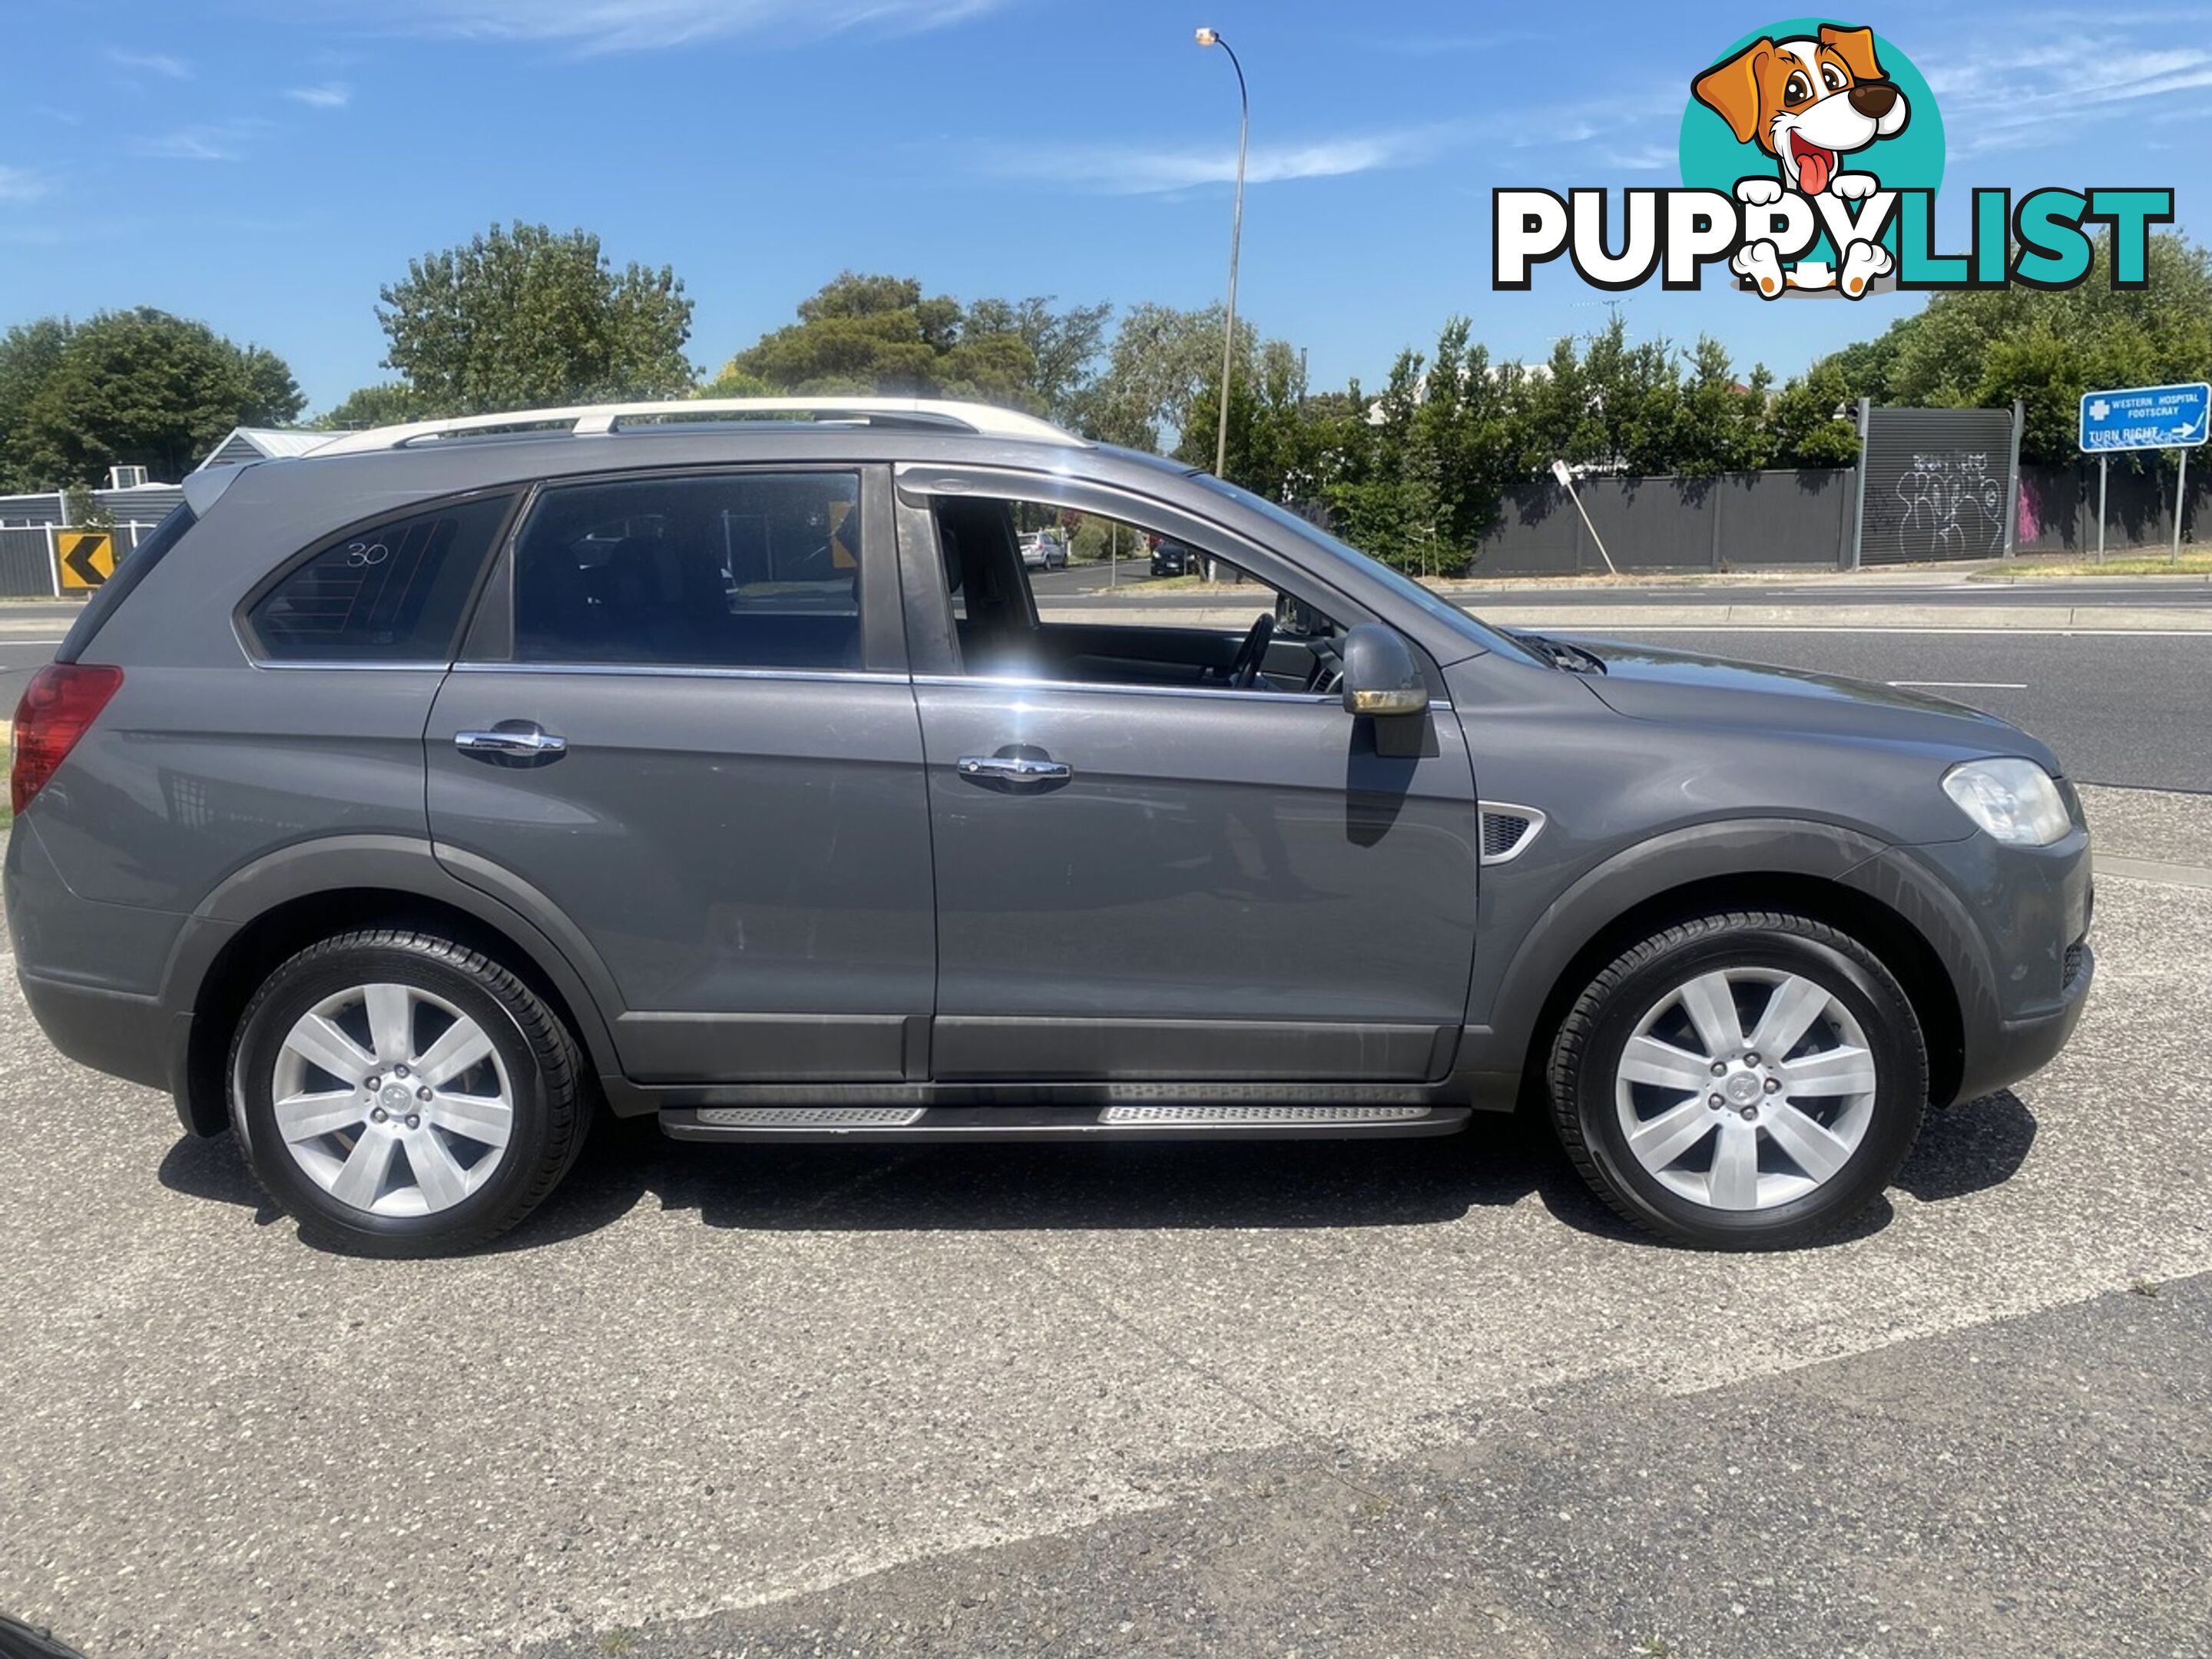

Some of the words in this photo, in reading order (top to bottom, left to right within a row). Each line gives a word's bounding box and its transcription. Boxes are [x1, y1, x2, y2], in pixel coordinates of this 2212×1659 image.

[2113, 398, 2152, 409] WESTERN
[2159, 394, 2198, 405] HOSPITAL
[2128, 406, 2179, 419] FOOTSCRAY
[2089, 429, 2120, 442] TURN
[2123, 426, 2159, 440] RIGHT
[347, 542, 389, 568] 30
